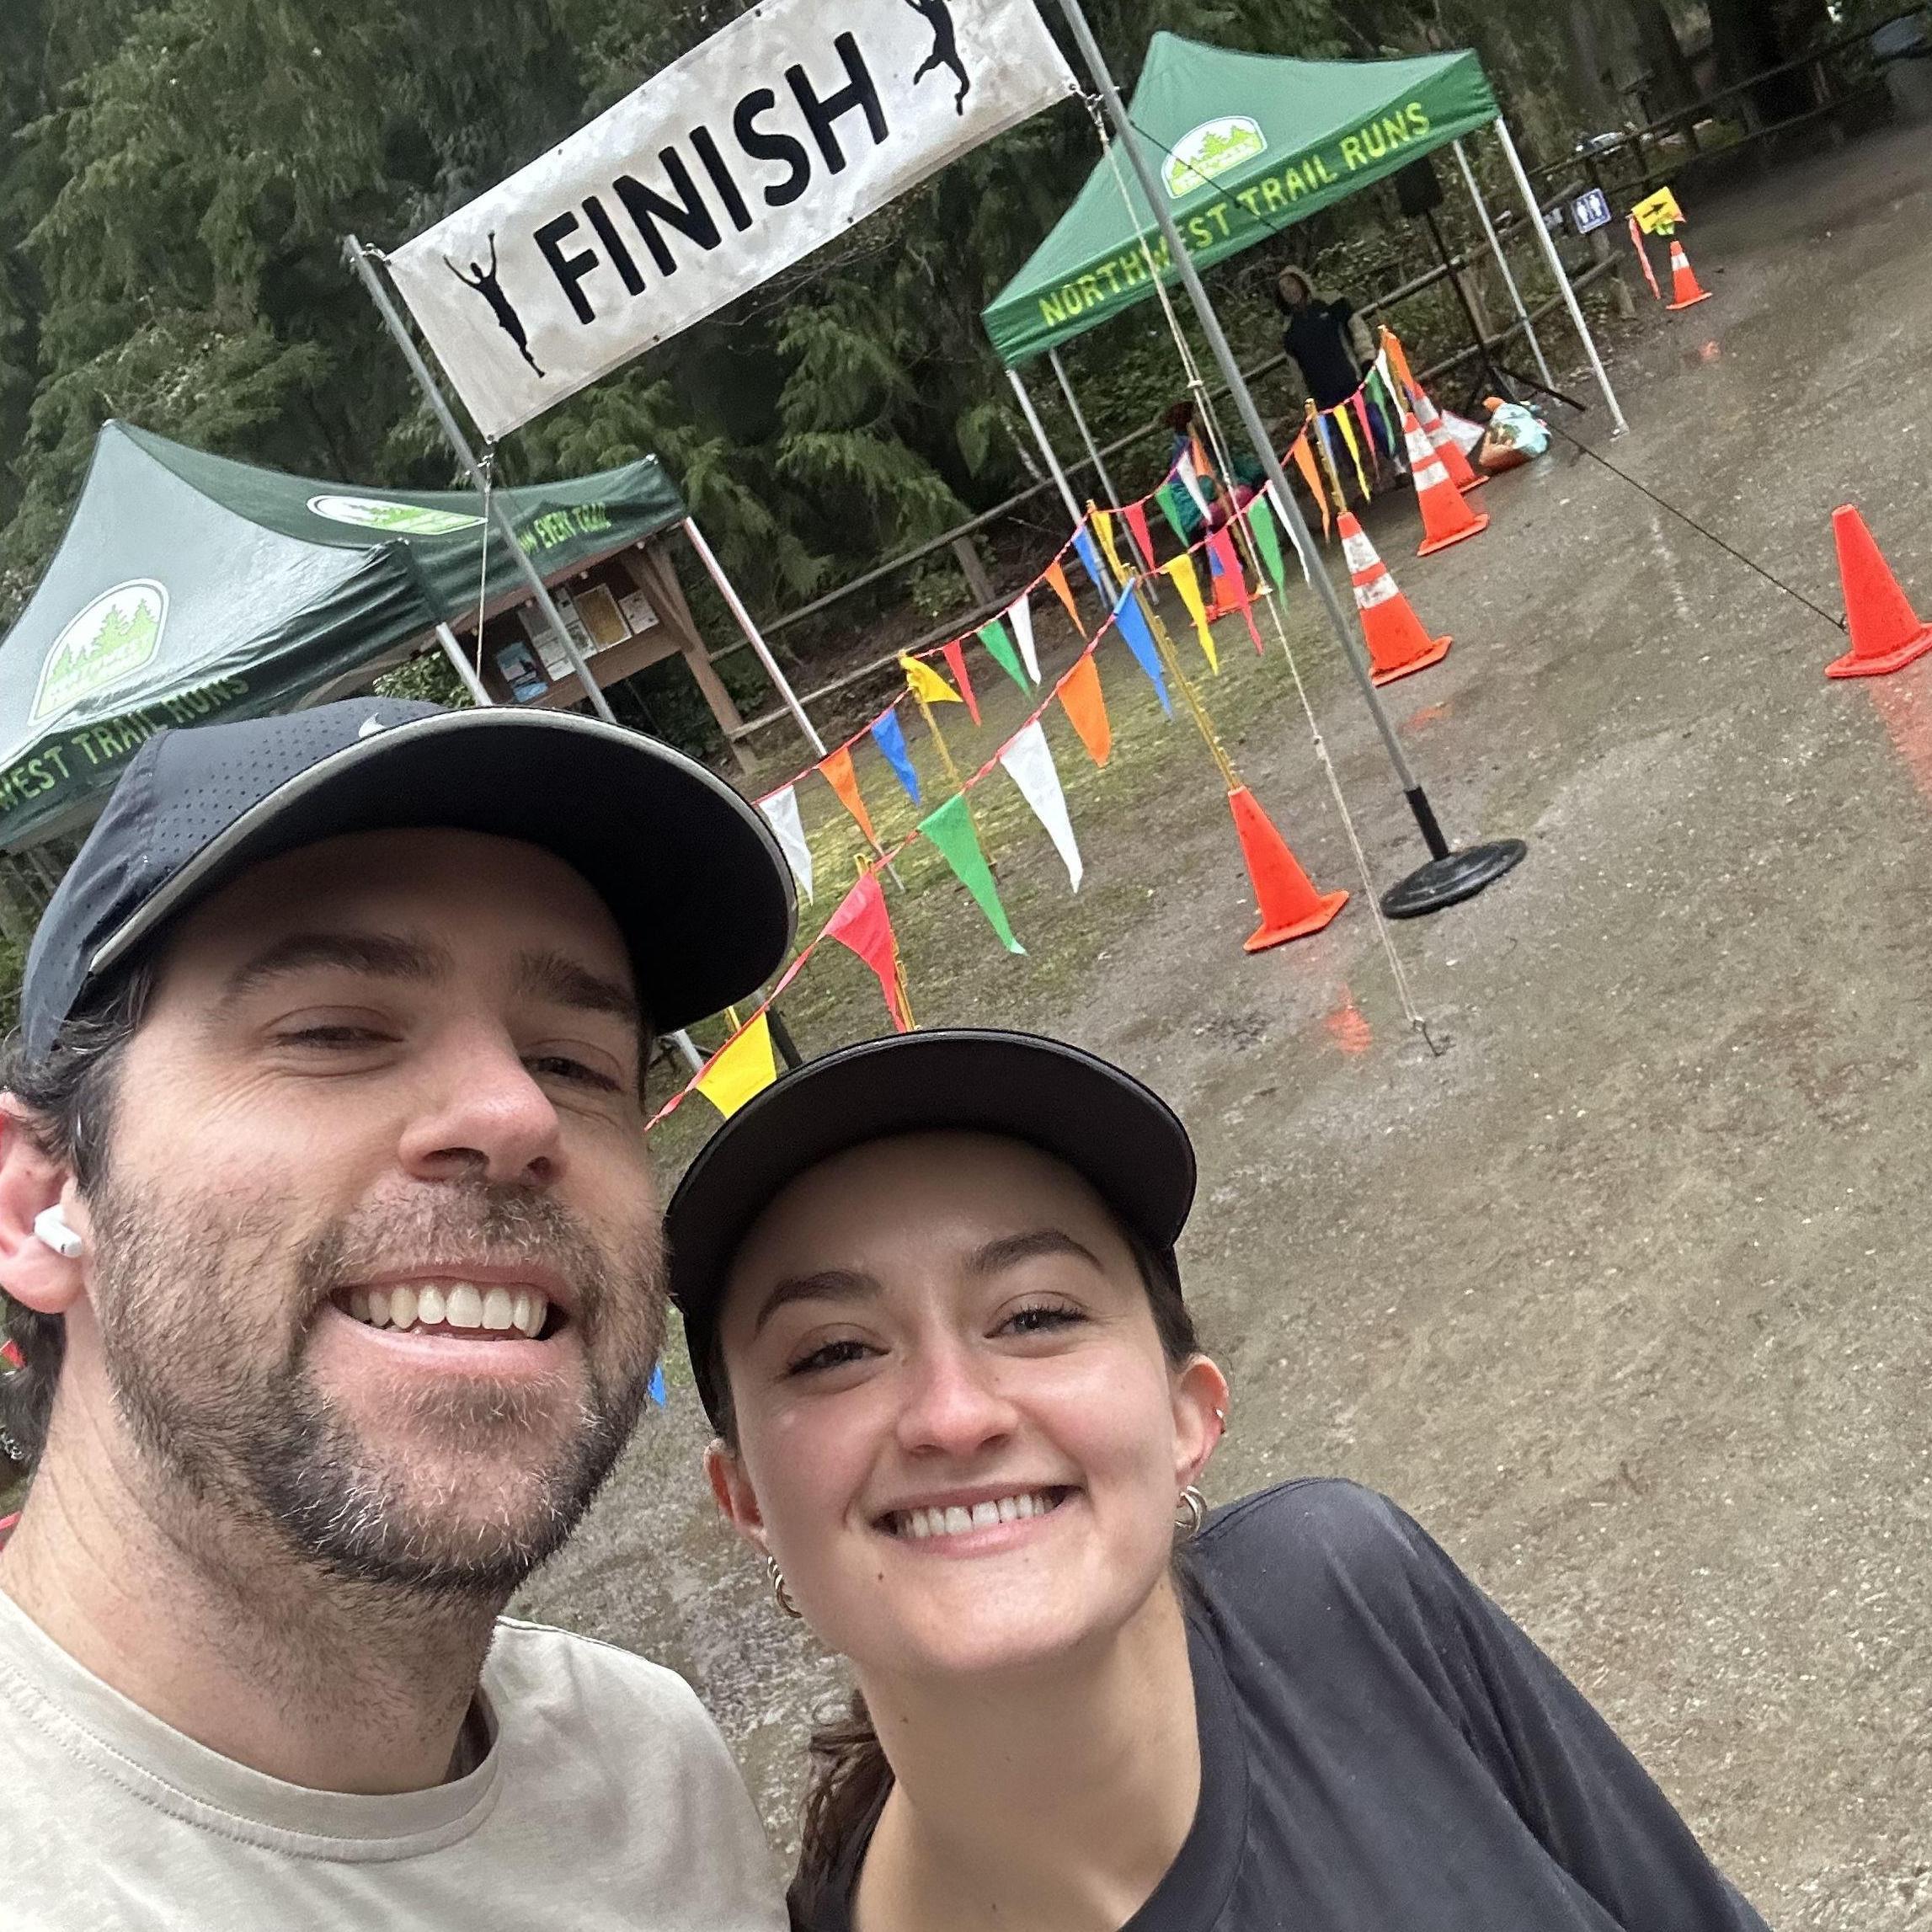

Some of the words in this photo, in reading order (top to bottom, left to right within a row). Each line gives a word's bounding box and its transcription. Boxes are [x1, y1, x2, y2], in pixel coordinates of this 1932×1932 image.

[533, 31, 889, 326] FINISH
[1237, 153, 1339, 217] TRAIL
[1339, 101, 1431, 171] RUNS
[71, 708, 168, 765] TRAIL
[160, 678, 250, 724] RUNS
